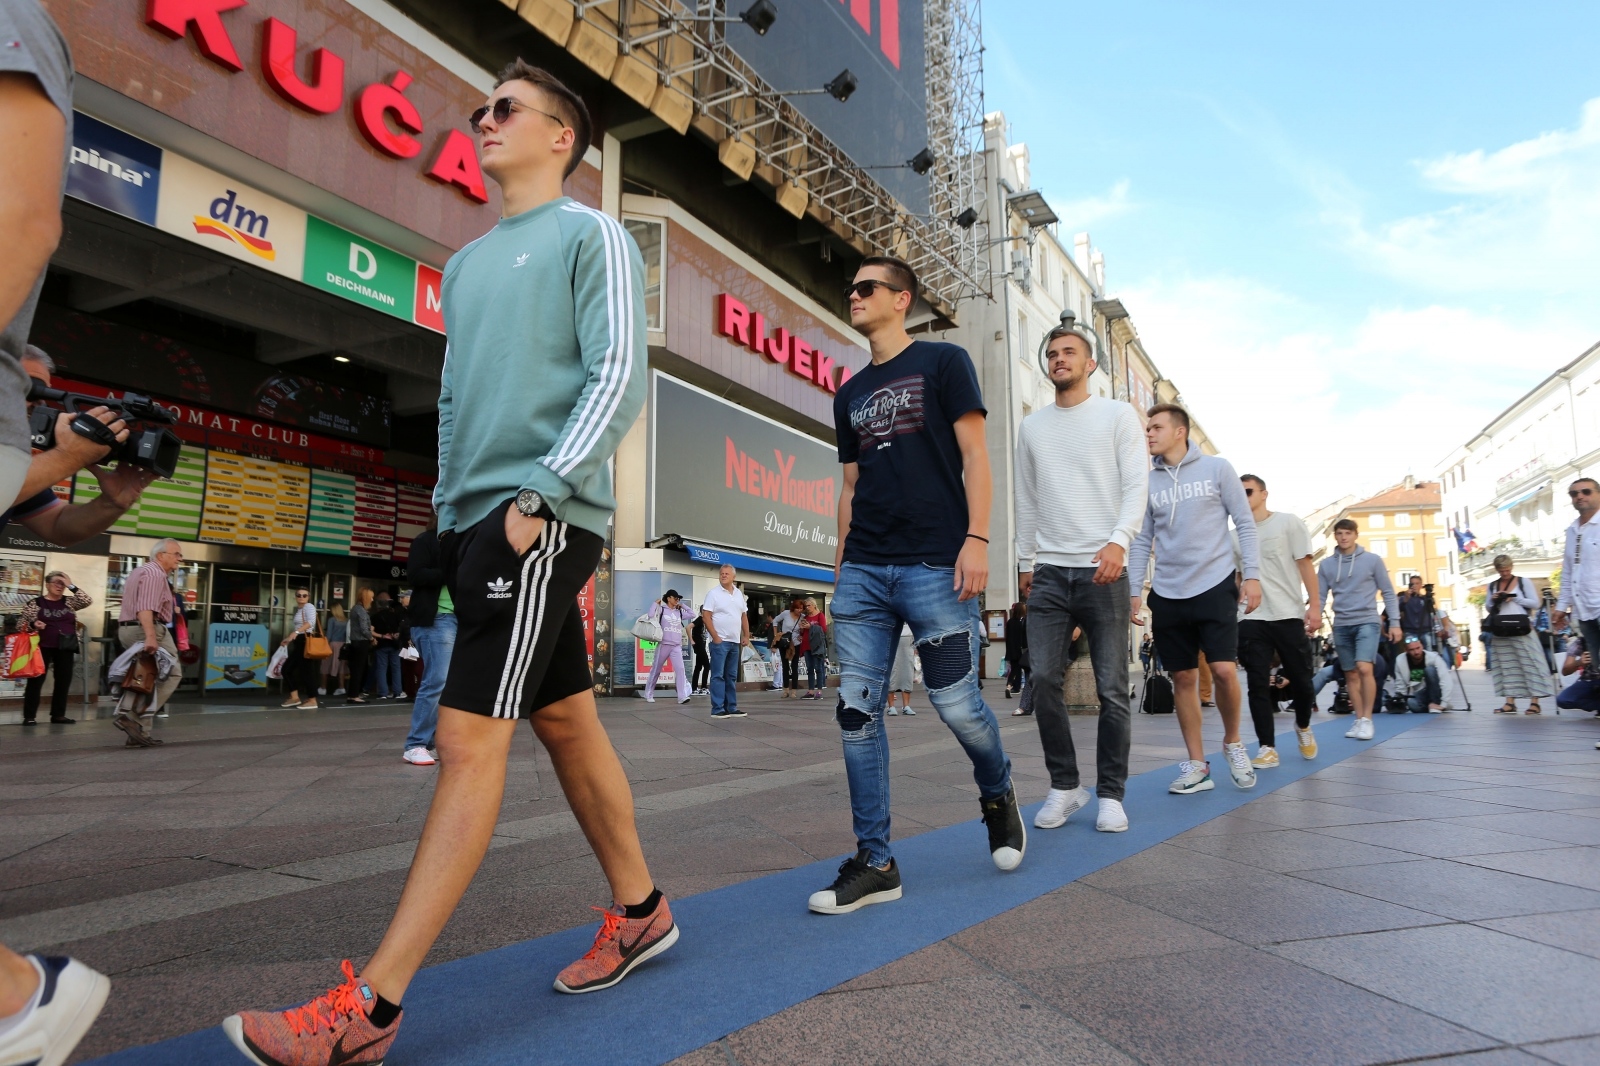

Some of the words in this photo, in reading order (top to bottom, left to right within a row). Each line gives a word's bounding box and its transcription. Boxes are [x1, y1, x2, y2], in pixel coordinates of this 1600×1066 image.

[146, 0, 488, 203] KUĆA
[209, 189, 269, 238] dm
[348, 241, 377, 280] D
[326, 272, 395, 307] DEICHMANN
[106, 391, 241, 432] AOMAT
[252, 423, 309, 447] CLUB
[334, 414, 350, 426] floor
[850, 400, 880, 429] Hard
[880, 388, 911, 416] Rock
[870, 417, 890, 429] CAFE
[1150, 480, 1214, 510] KALIBRE
[8, 536, 45, 548] Tobacco
[763, 511, 793, 537] Dress
[792, 520, 809, 543] for
[812, 525, 825, 544] the
[694, 549, 720, 561] TOBACCO
[213, 645, 251, 658] DREAMS
[214, 629, 252, 644] HAPPY
